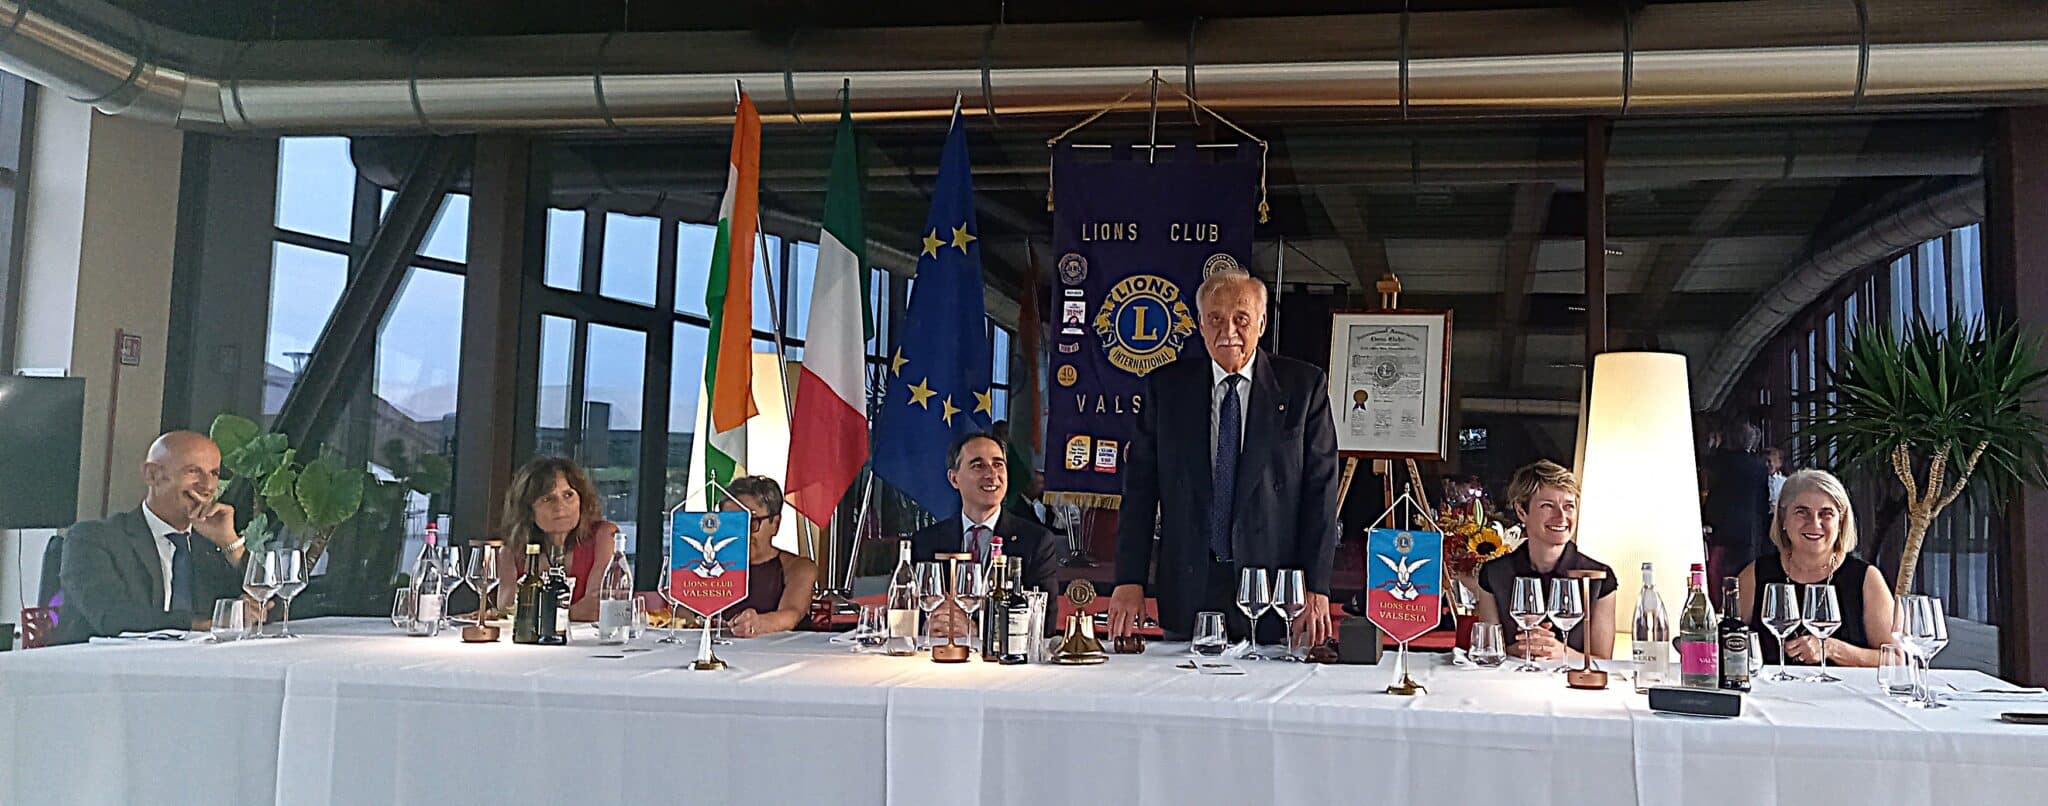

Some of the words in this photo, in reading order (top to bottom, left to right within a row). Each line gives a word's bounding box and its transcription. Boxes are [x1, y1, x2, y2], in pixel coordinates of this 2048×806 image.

[1082, 223, 1138, 241] LIONS
[1170, 223, 1219, 242] CLUB
[1119, 277, 1175, 301] LIONS
[1131, 306, 1158, 341] L
[1112, 351, 1174, 369] INTERNATIONAL
[1076, 394, 1142, 414] VALS
[1072, 456, 1082, 466] 5
[683, 580, 708, 588] LIONS
[710, 580, 734, 588] CLUB
[683, 589, 733, 598] VALSESIA
[1380, 601, 1404, 610] LIONS
[1406, 604, 1427, 612] CLUB
[1380, 612, 1426, 622] VALSESIA
